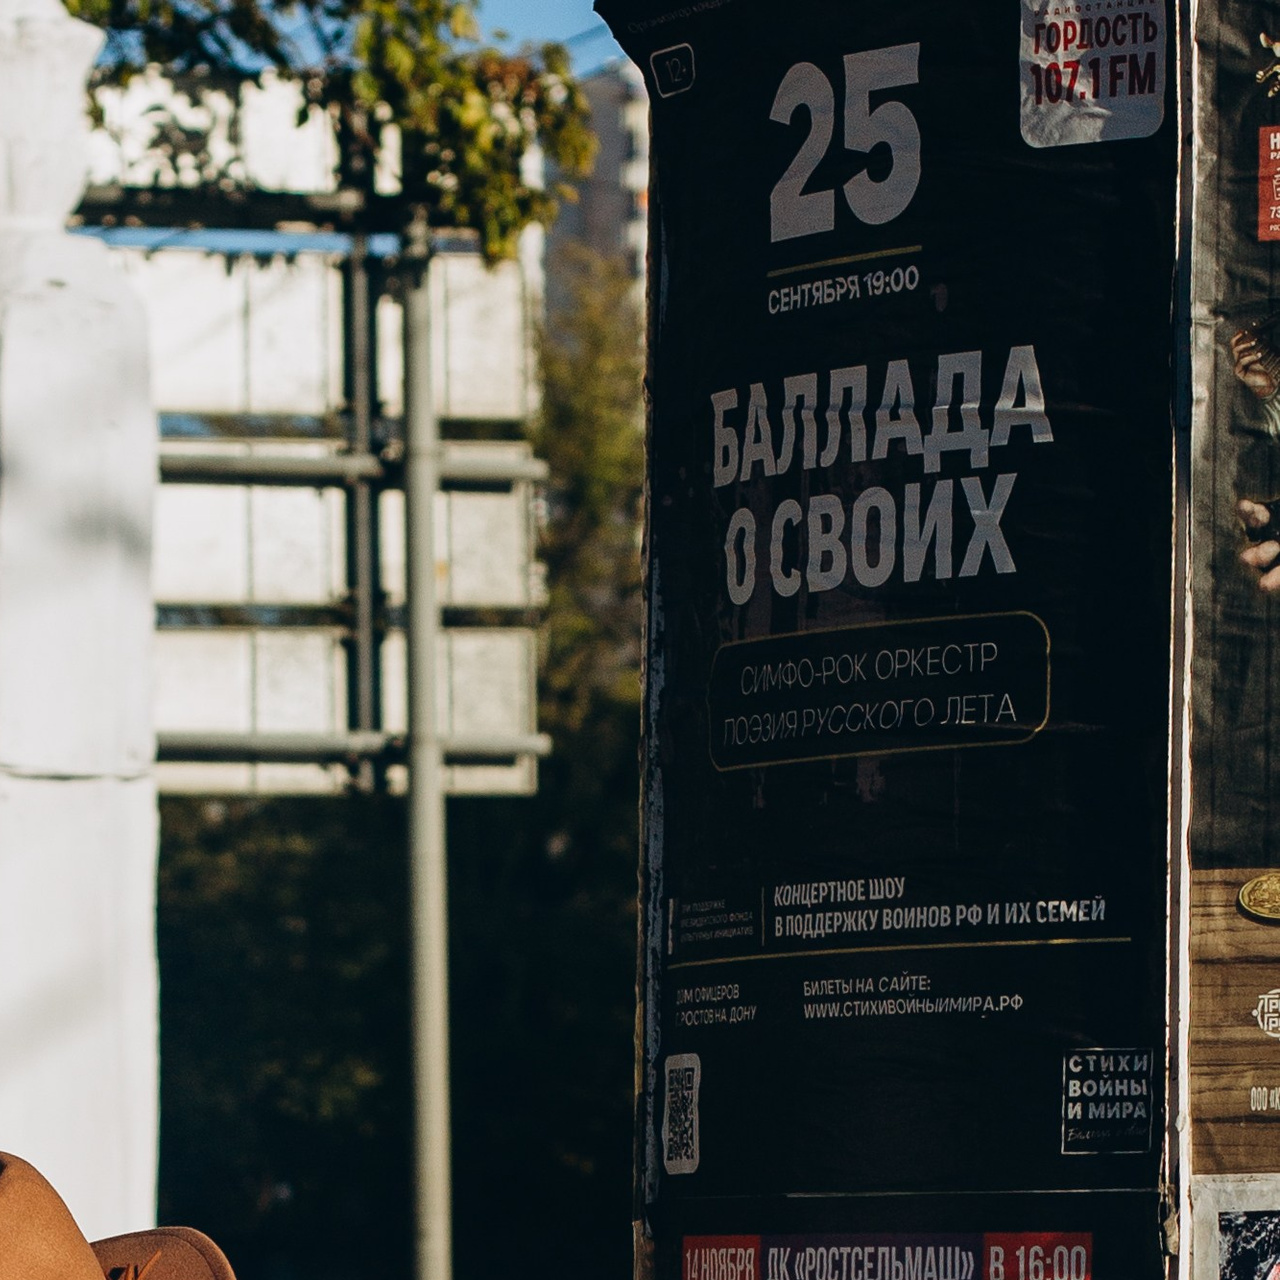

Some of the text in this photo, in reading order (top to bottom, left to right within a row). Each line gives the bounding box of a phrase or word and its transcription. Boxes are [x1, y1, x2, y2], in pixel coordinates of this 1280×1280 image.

[1034, 12, 1157, 54] ГОРДОСТЬ
[1030, 52, 1156, 105] 107.1 FM
[768, 41, 921, 242] 25
[768, 264, 920, 315] СЕНТЯБРЯ 19:00
[710, 344, 1055, 489] БАЛЛАДА
[724, 472, 1018, 606] О СВОИХ
[740, 641, 998, 695] СИМФО-РОК ОРКЕСТР
[723, 692, 1017, 746] ПОЭЗИЯ РУССКОГО ЛЕТА
[773, 876, 906, 908] КОНЦЕРТНОЕ ШОУ
[774, 894, 1106, 940] В ПОДДЕРЖКУ ВОИНОВ РФ И ИХ СЕМЕЙ
[694, 983, 740, 1003] ОФИЦЕРОВ
[803, 971, 931, 997] БИЛЕТЫ НА САЙТЕ:
[729, 1004, 757, 1024] ДОНУ
[1068, 1054, 1148, 1073] СТИХИ
[1068, 1073, 1148, 1098] ВОЙНЫ
[1067, 1101, 1147, 1120] И МИРА
